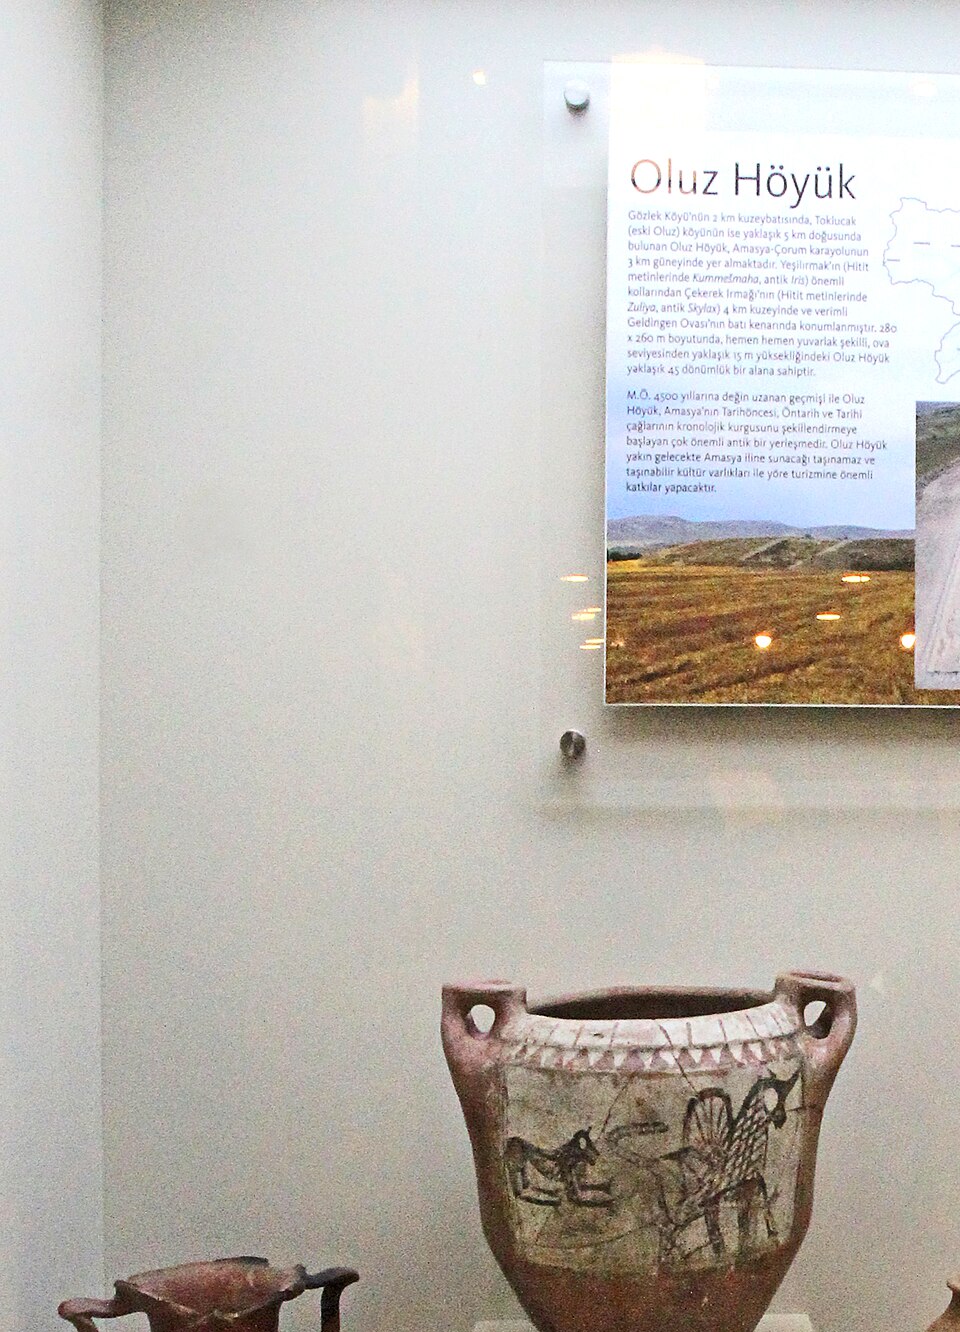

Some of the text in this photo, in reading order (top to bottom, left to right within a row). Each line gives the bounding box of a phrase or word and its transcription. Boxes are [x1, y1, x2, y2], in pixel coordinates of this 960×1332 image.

[630, 157, 857, 209] Oluz Höyük
[627, 209, 662, 221] Gözlek
[664, 210, 710, 224] Köyü'nün
[712, 214, 718, 222] 2
[720, 211, 736, 222] km
[815, 213, 856, 225] Toklucak
[627, 239, 668, 251] bulunan
[669, 240, 693, 252] Oluz
[732, 241, 807, 257] Amasya-Çorum
[809, 243, 869, 258] karayolunun
[627, 285, 868, 302] kollarından Çekerek Irmağı'nın (Hitit metinlerinde
[627, 316, 678, 331] Geldingen
[680, 317, 725, 329] Ovası'nın
[727, 318, 747, 330] batı
[748, 319, 797, 331] kenarında
[879, 321, 898, 333] 280
[627, 348, 690, 362] seviyesinden
[691, 348, 730, 363] yaklaşık
[733, 352, 742, 363] 15
[755, 349, 831, 364] yüksekliğindeki
[832, 350, 856, 362] Oluz
[858, 351, 890, 365] Höyük
[653, 393, 679, 404] 4500
[680, 390, 720, 405] yıllarına
[722, 391, 749, 405] değin
[751, 395, 787, 403] uzanan
[789, 393, 826, 407] geçmişi
[828, 392, 840, 404] ile
[842, 392, 865, 404] Oluz
[664, 405, 719, 420] Amasya'nın
[781, 405, 820, 418] Öntarih
[822, 410, 834, 418] ve
[836, 407, 863, 419] Tarihi
[626, 435, 669, 450] başlayan
[670, 435, 689, 450] çok
[690, 436, 724, 447] önemli
[726, 436, 752, 448] antik
[753, 436, 766, 448] bir
[830, 437, 854, 449] Oluz
[855, 438, 888, 452] Höyük
[625, 450, 876, 467] yakın gelecekte Amasya iline sunacağı taşınamaz ve
[625, 465, 873, 481] taşınabilir kültür varlıkları ile yöre turizmine önemli
[625, 480, 662, 492] katkılar
